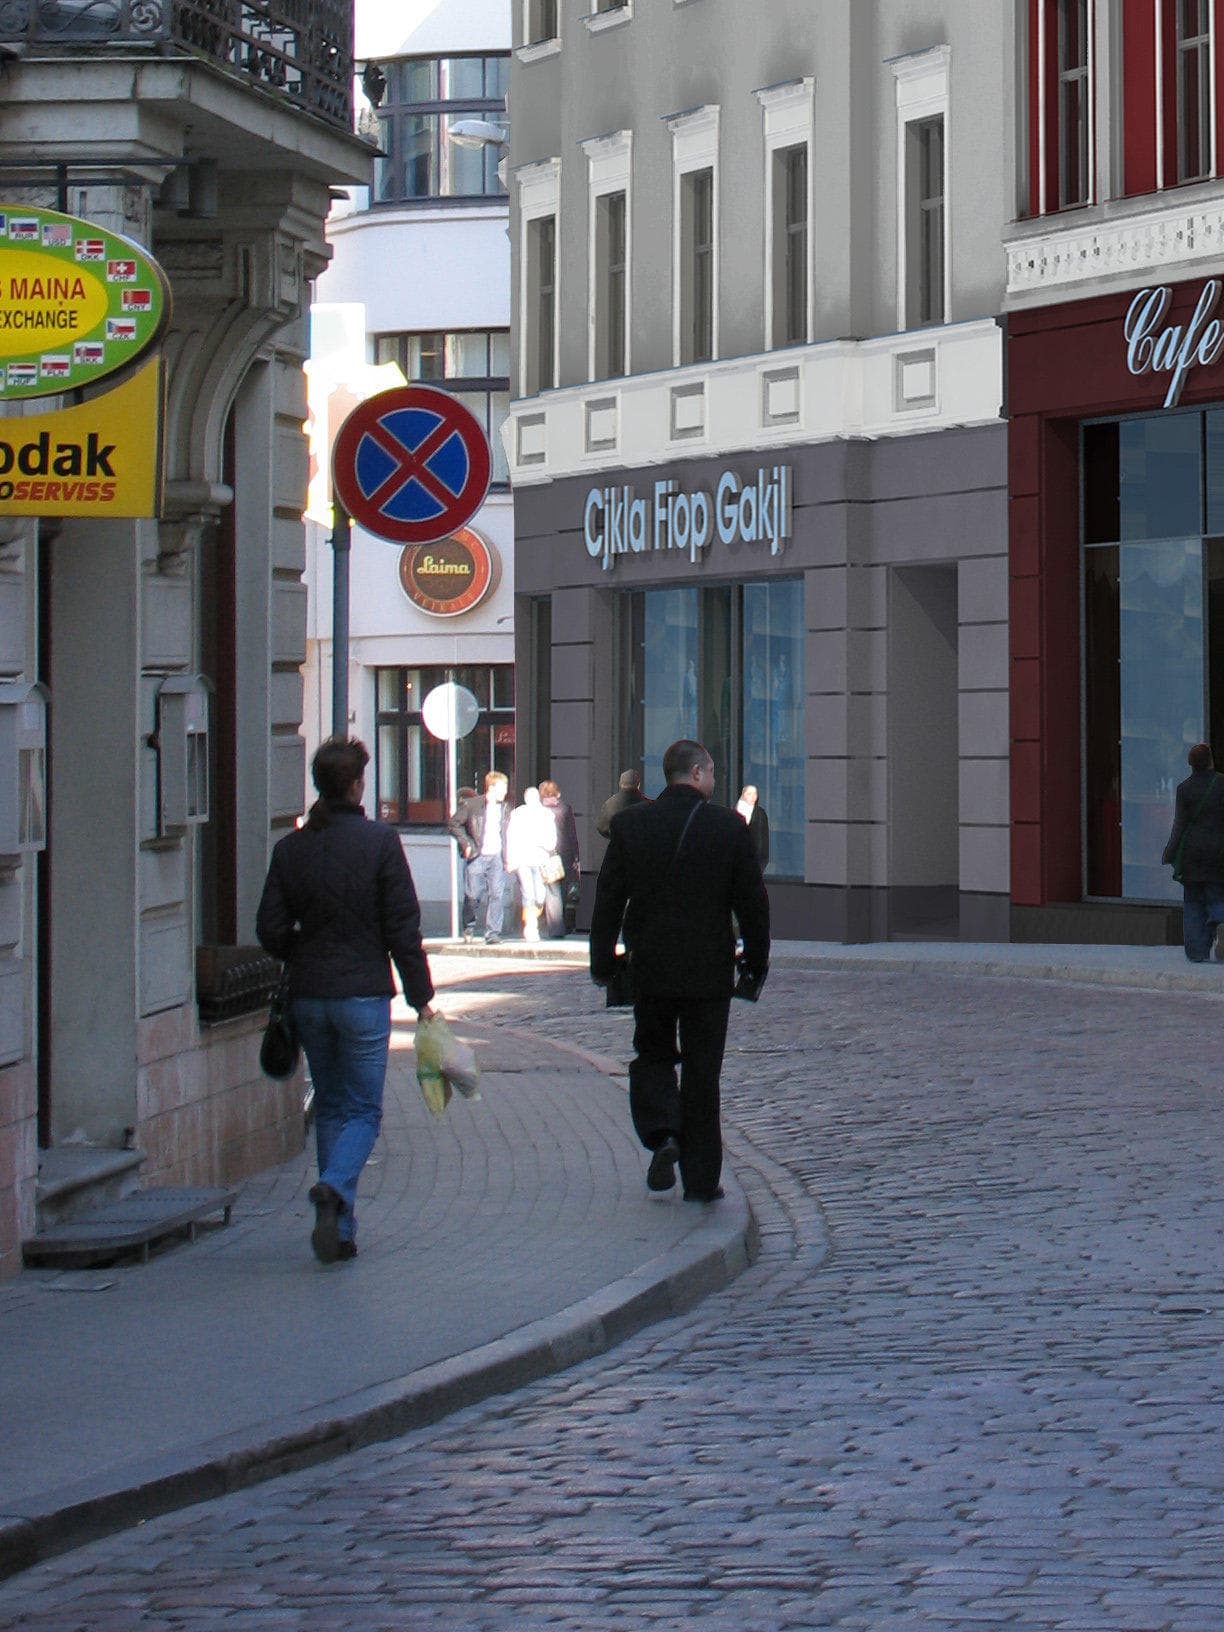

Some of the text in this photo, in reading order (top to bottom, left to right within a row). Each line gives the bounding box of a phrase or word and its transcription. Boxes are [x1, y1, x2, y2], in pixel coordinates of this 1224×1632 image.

[10, 277, 86, 306] MAIŅA
[0, 310, 78, 329] XCHANGE
[416, 555, 471, 575] Laima
